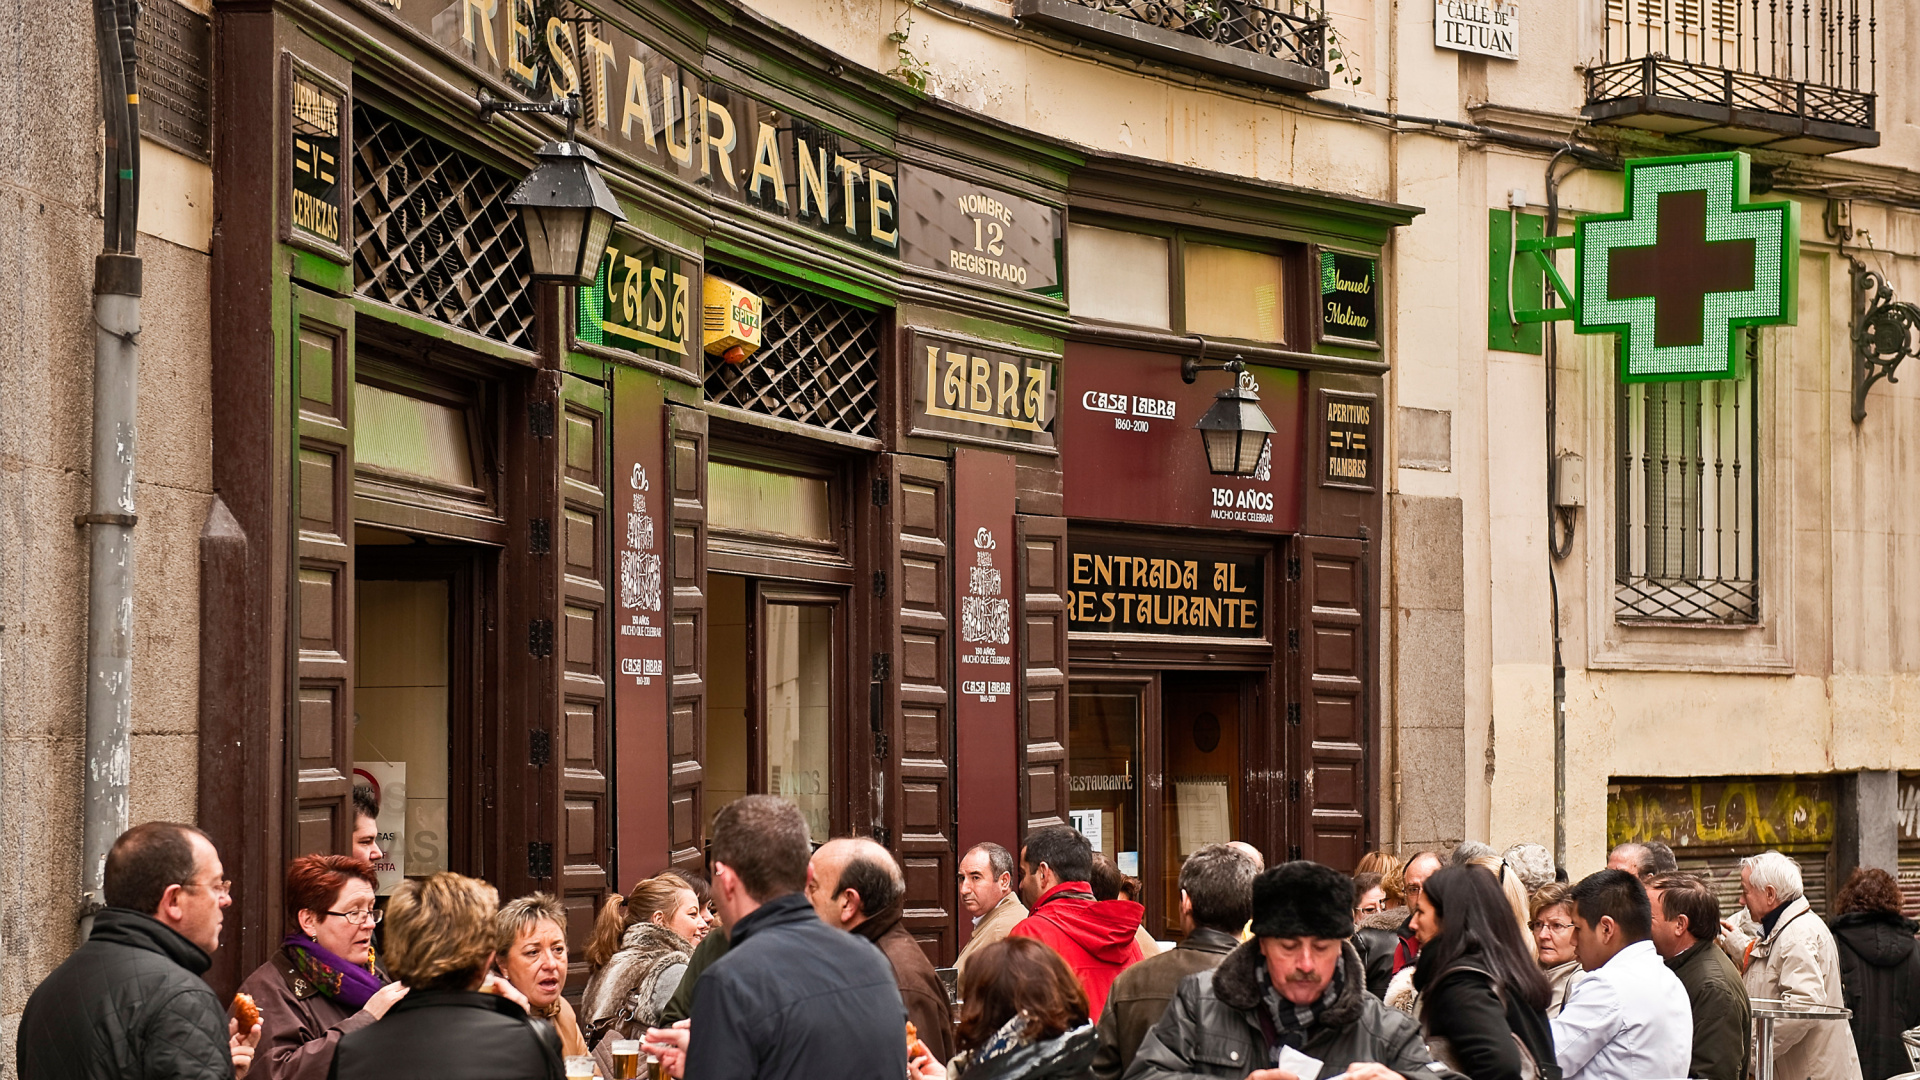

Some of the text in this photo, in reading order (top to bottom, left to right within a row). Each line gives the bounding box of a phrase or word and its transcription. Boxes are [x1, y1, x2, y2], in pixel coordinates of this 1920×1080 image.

[1448, 0, 1510, 27] CALLE DE
[1443, 20, 1512, 52] TETUAN
[293, 80, 339, 138] VERMUTS
[463, 0, 898, 250] RESTAURANTE
[312, 144, 319, 180] Y
[293, 188, 339, 242] CERVEZAS
[958, 194, 1013, 228] NOMBRE
[973, 218, 1005, 257] 12
[950, 249, 1027, 286] REGISTRADO
[1325, 267, 1371, 295] Manuel
[734, 306, 760, 328] SPITZ
[1324, 301, 1369, 328] Molina
[925, 345, 1047, 433] LABRA
[1082, 390, 1176, 420] CASA LABRA
[1327, 402, 1370, 425] APERITIVOS
[1114, 417, 1149, 433] 1860-2010
[1345, 431, 1352, 450] Y
[1329, 456, 1367, 479] FIAMBRES
[1211, 487, 1274, 511] 150 AÑOS
[1210, 509, 1274, 523] MUCHO QUE CELEBRAR
[1073, 553, 1247, 593] ENTRADA AL
[1067, 590, 1258, 629] RESTAURANTE
[621, 658, 663, 676] CASA LABRA
[962, 680, 1011, 696] CASA LABRA
[1068, 774, 1134, 792] RESTAURANTE
